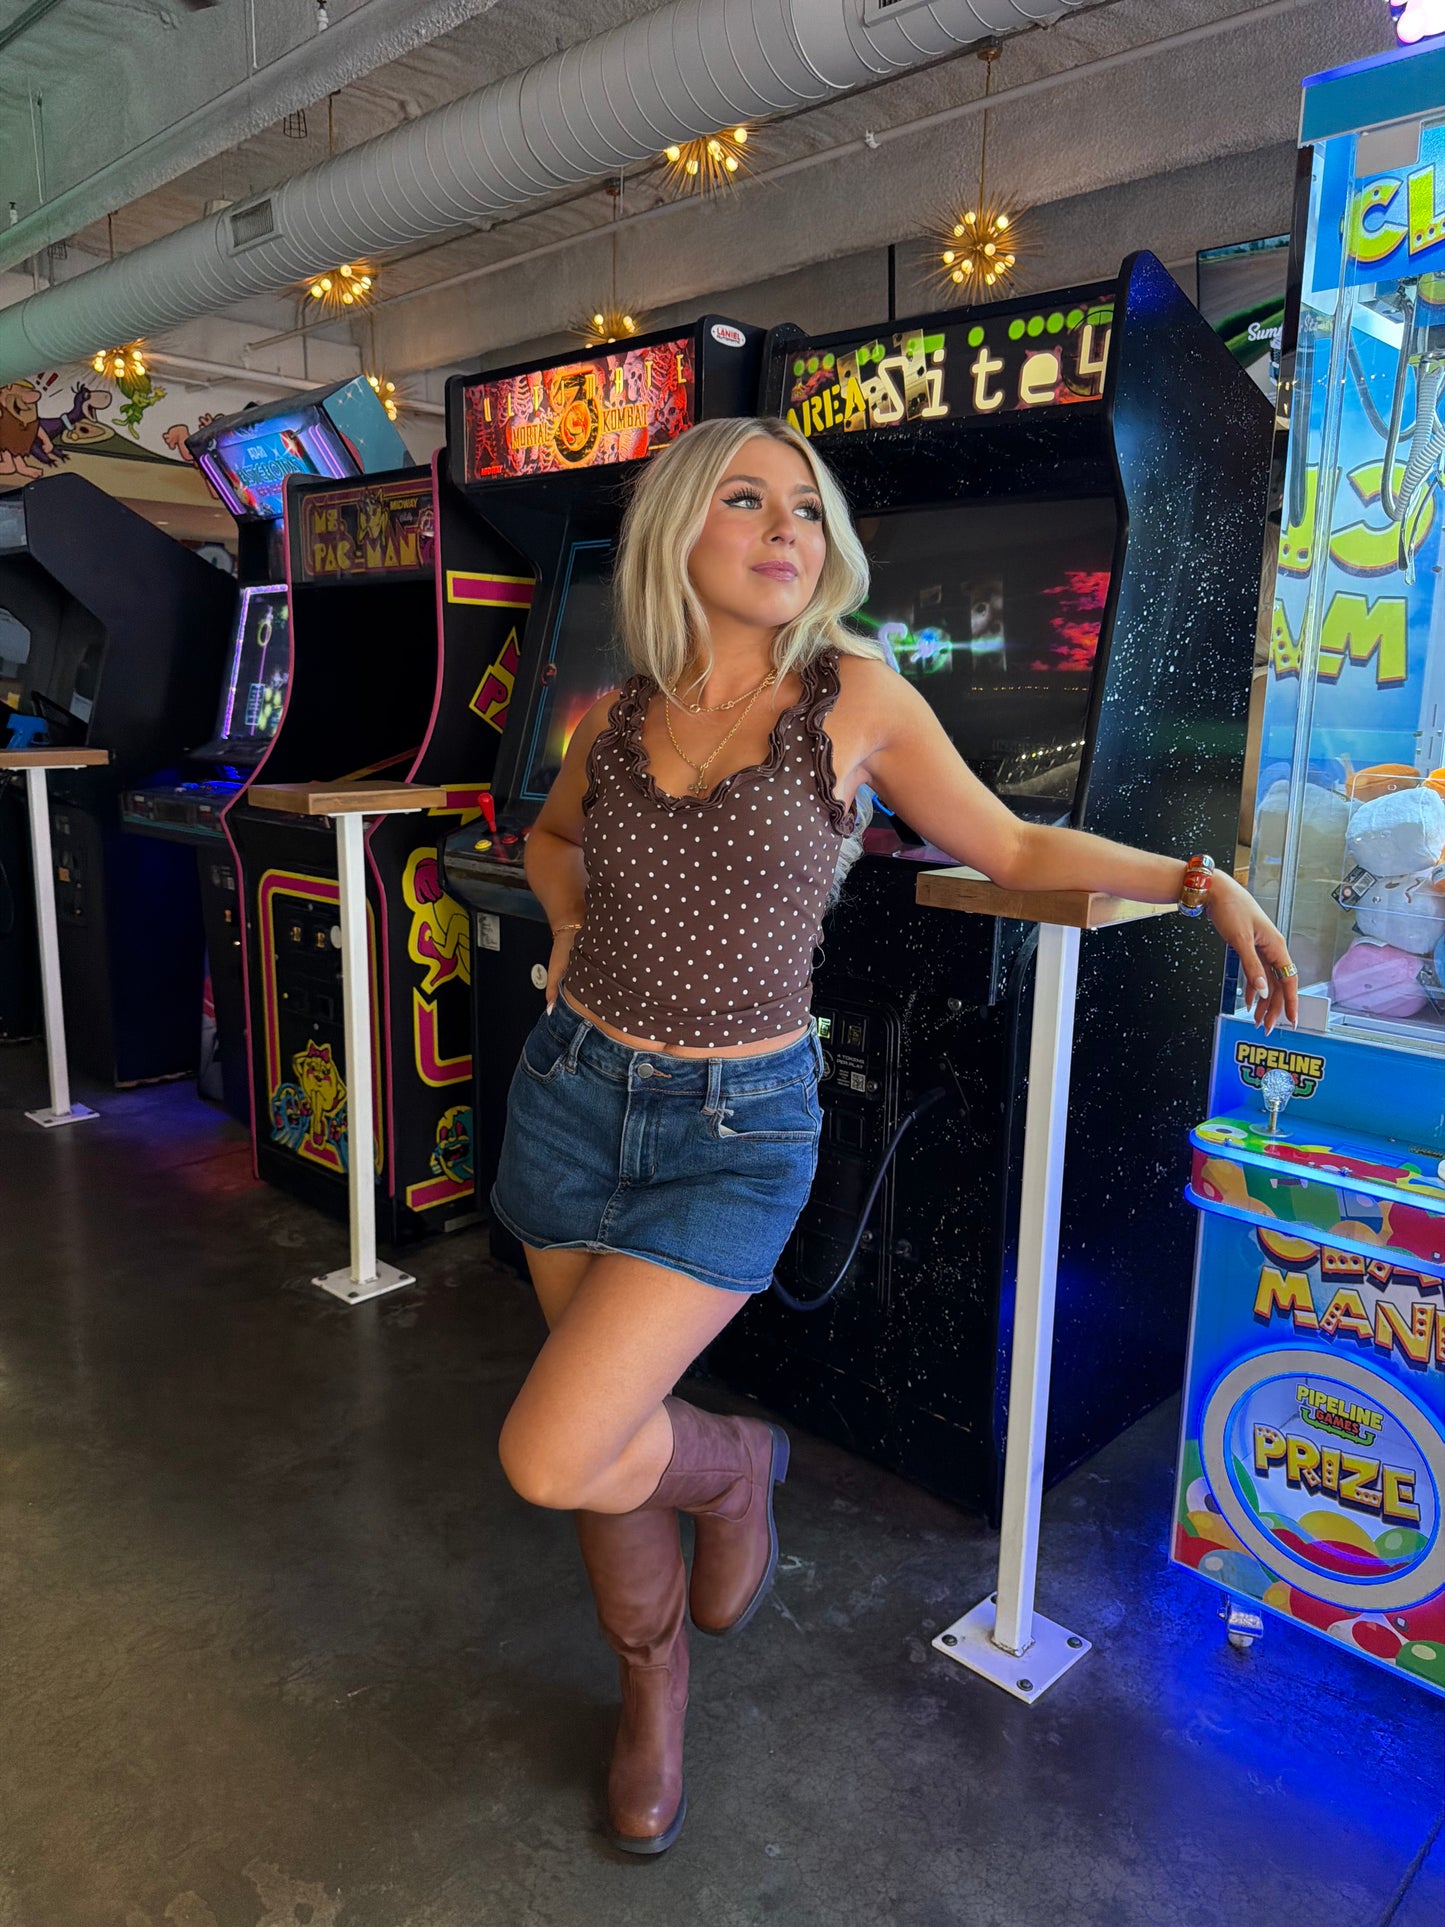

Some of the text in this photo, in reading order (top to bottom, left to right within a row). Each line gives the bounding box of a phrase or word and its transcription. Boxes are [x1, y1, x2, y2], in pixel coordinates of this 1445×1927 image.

[511, 421, 551, 451] MORTAL
[602, 402, 652, 435] KOMBAT
[786, 376, 867, 437] AREA
[1237, 1043, 1323, 1078] PIPELINE
[1296, 1384, 1384, 1432] PIPELINE
[1314, 1408, 1361, 1436] GAMES
[1253, 1422, 1421, 1525] PRIZE
